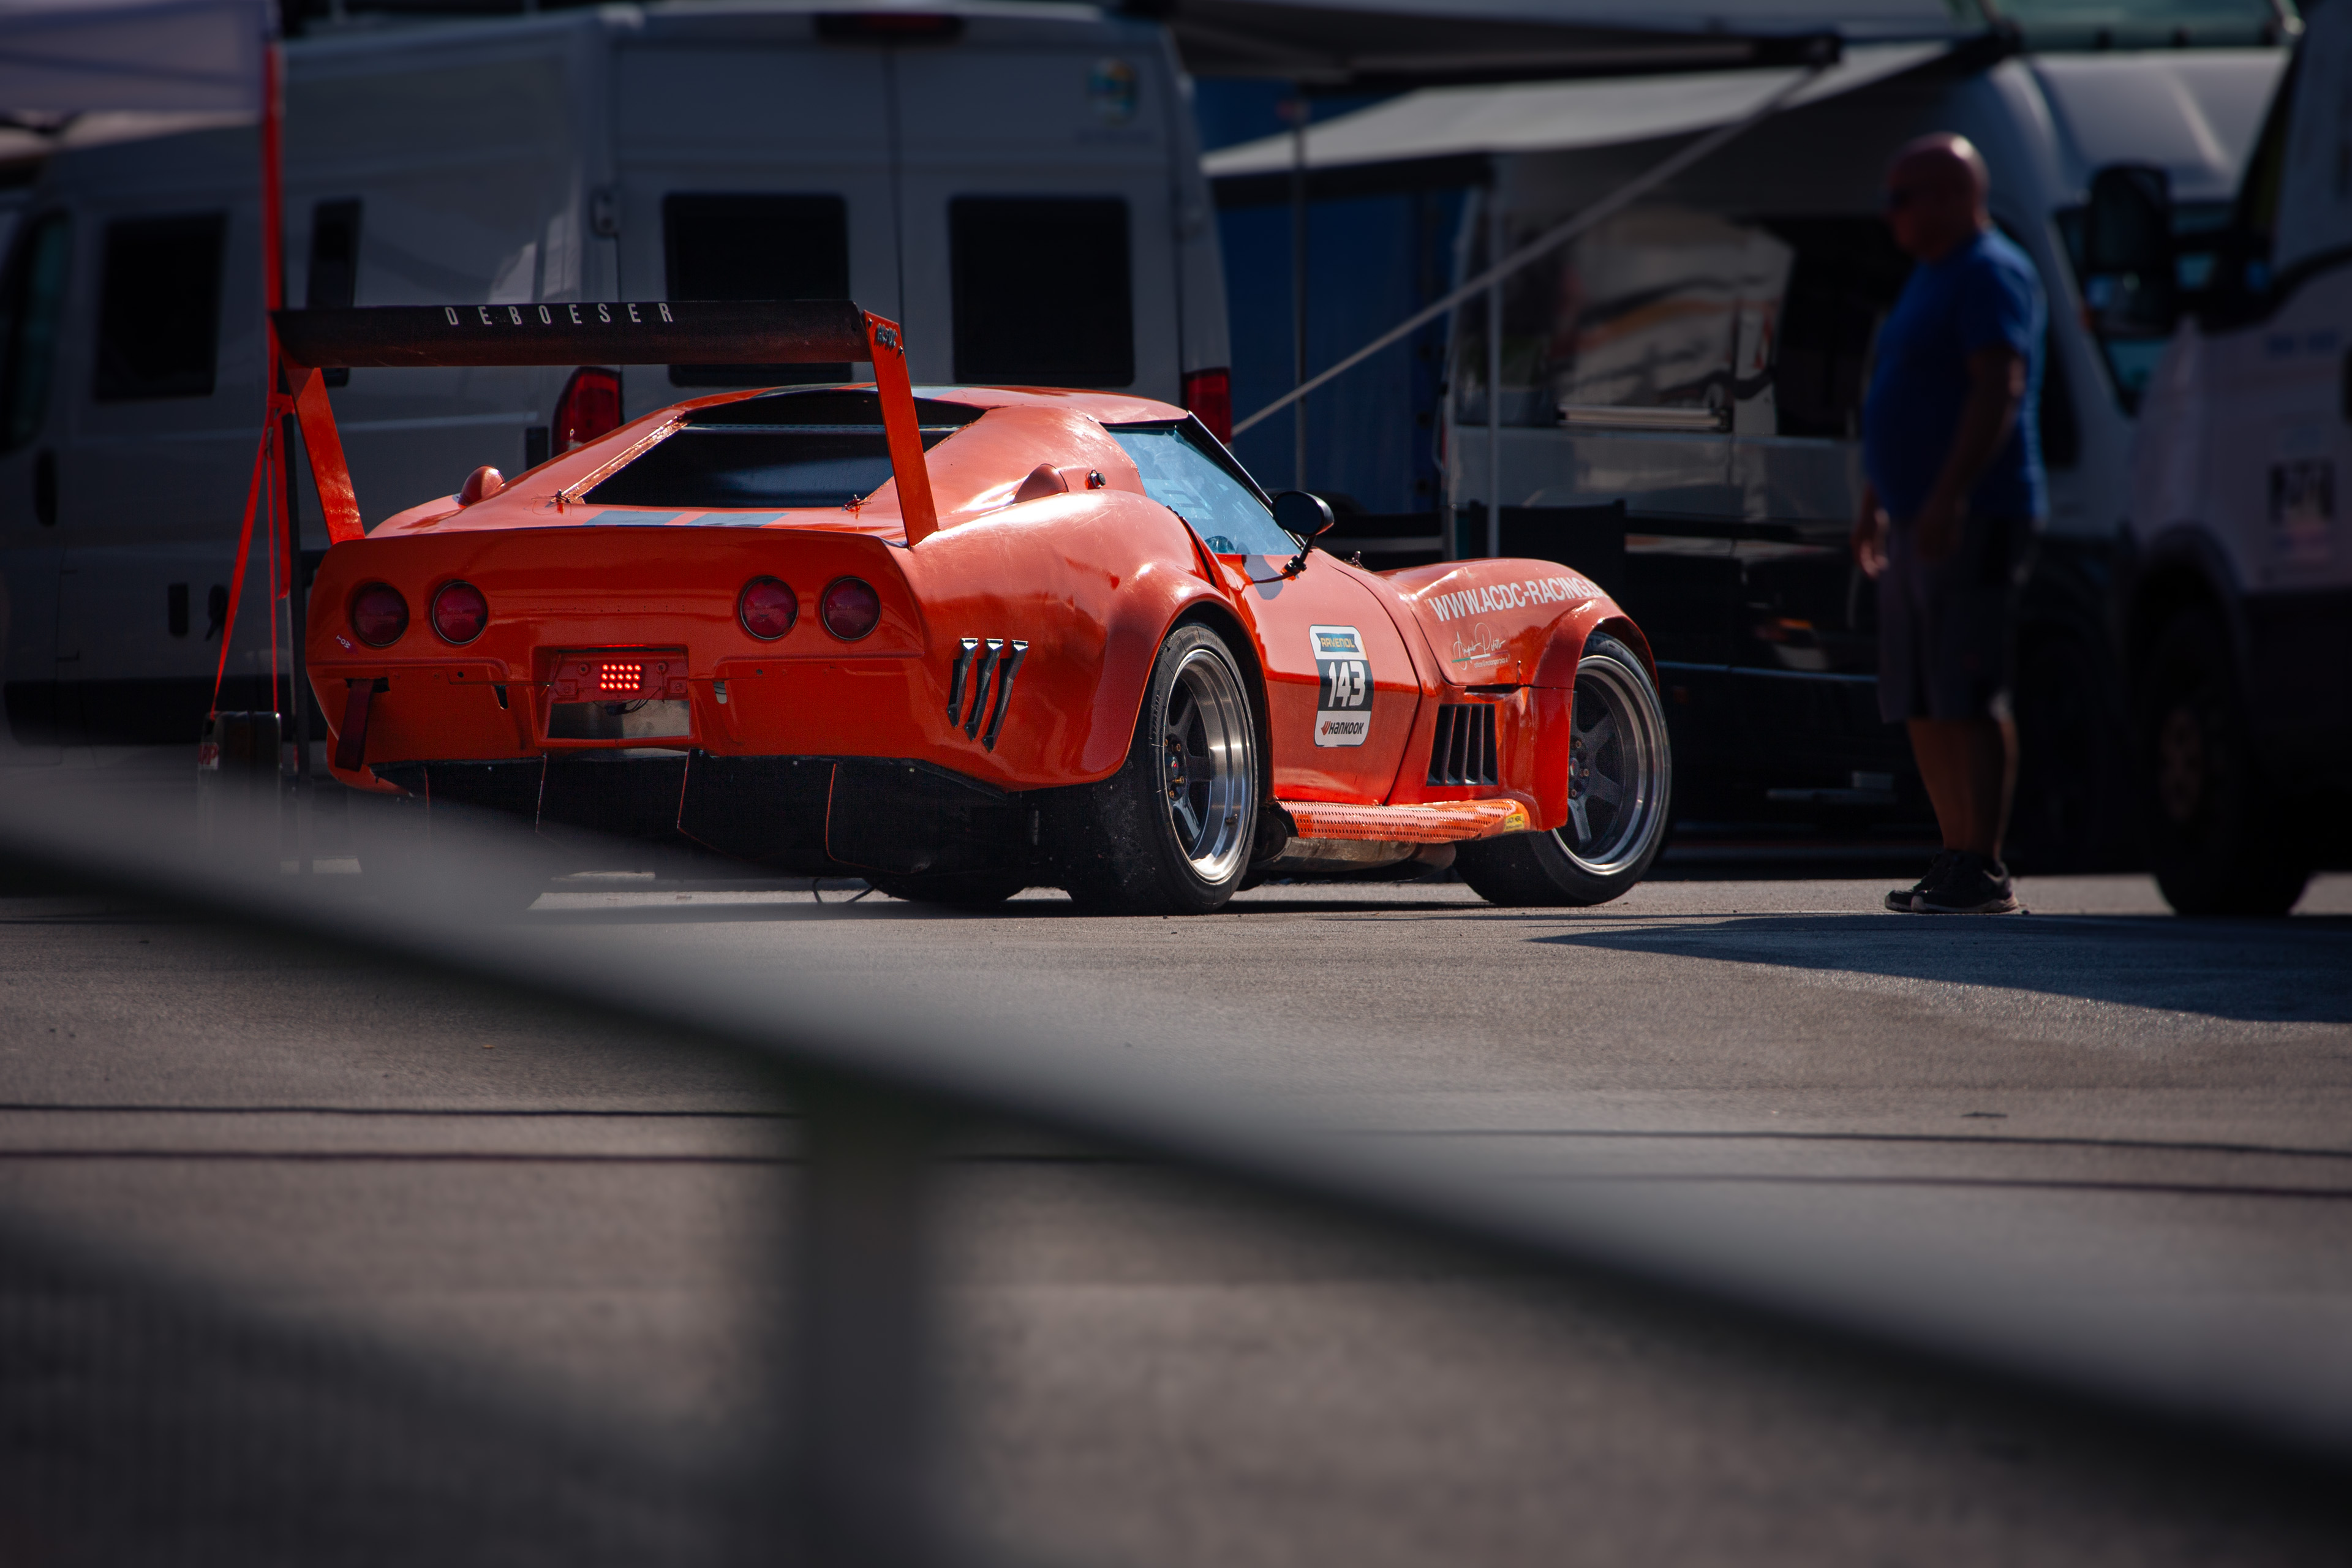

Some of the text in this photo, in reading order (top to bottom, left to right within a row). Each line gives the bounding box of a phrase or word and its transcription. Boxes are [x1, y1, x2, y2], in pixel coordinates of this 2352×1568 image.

[444, 302, 674, 325] DEBOESER
[335, 634, 351, 649] TOW
[1320, 637, 1355, 648] RAVENOL
[1327, 660, 1366, 708] 143
